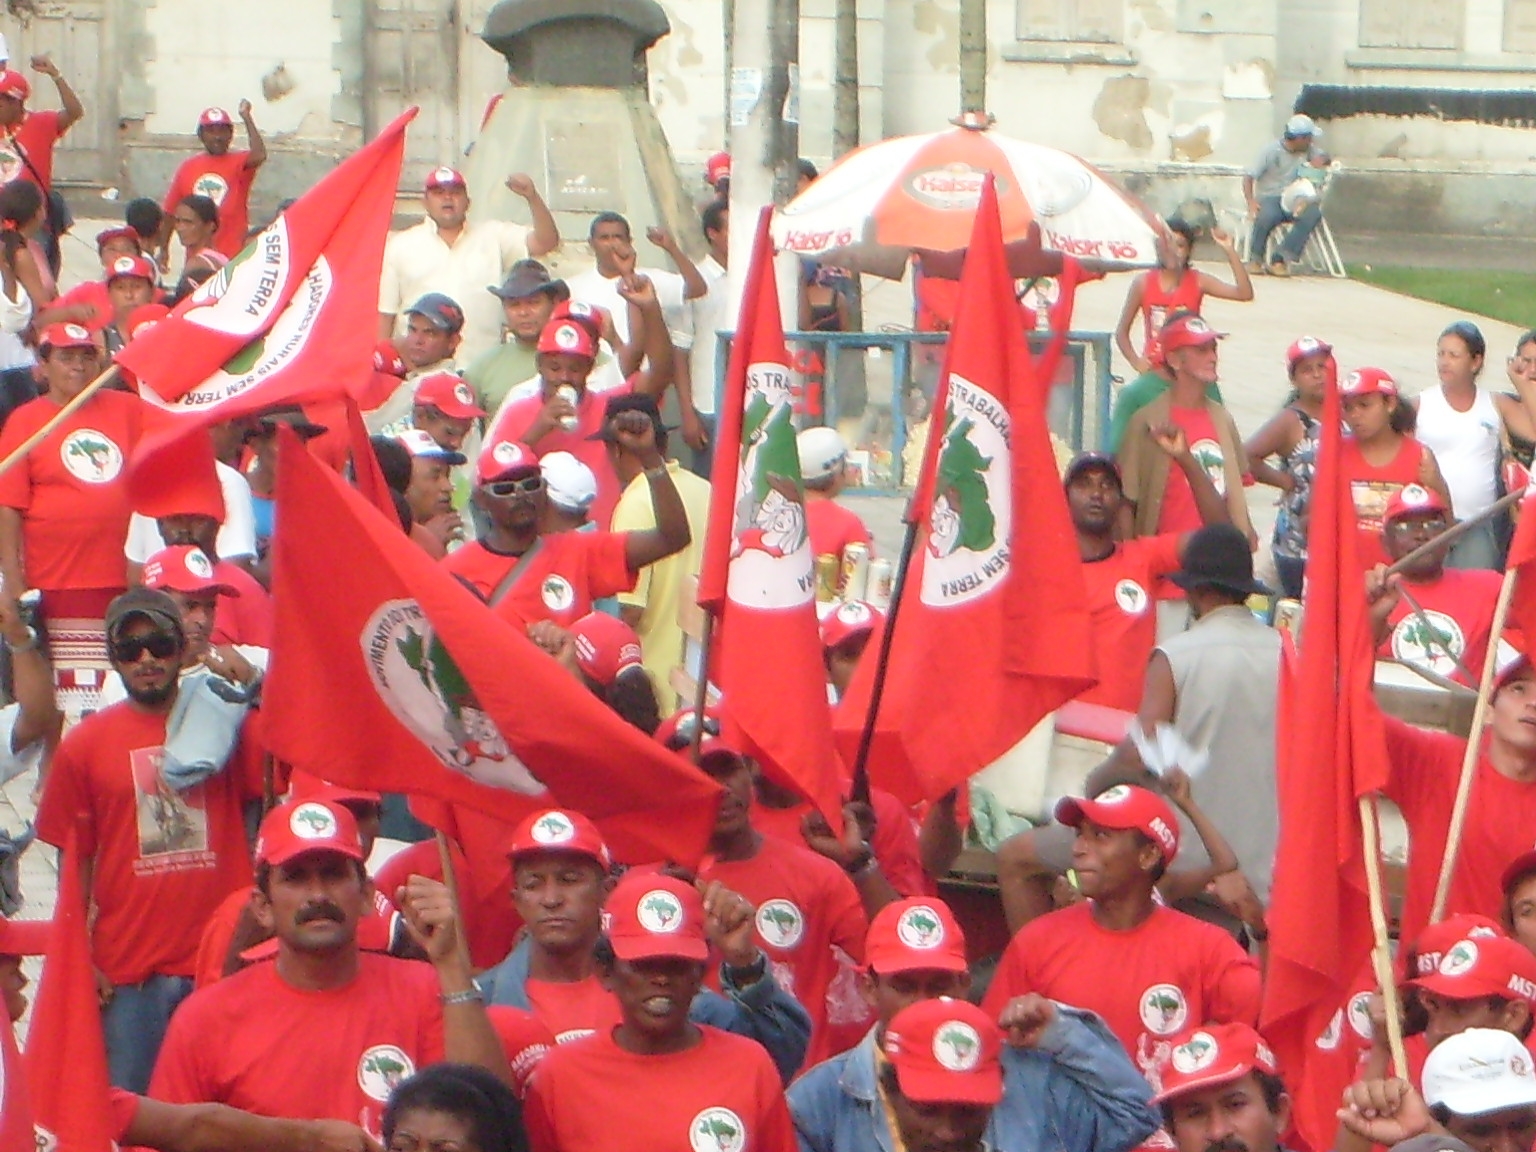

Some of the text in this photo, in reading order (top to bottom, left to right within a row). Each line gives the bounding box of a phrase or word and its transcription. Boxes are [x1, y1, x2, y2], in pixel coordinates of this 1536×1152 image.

[920, 175, 983, 192] Kaise
[245, 234, 281, 316] SEM TERRA
[941, 571, 984, 598] TERRA
[1148, 816, 1176, 850] MST
